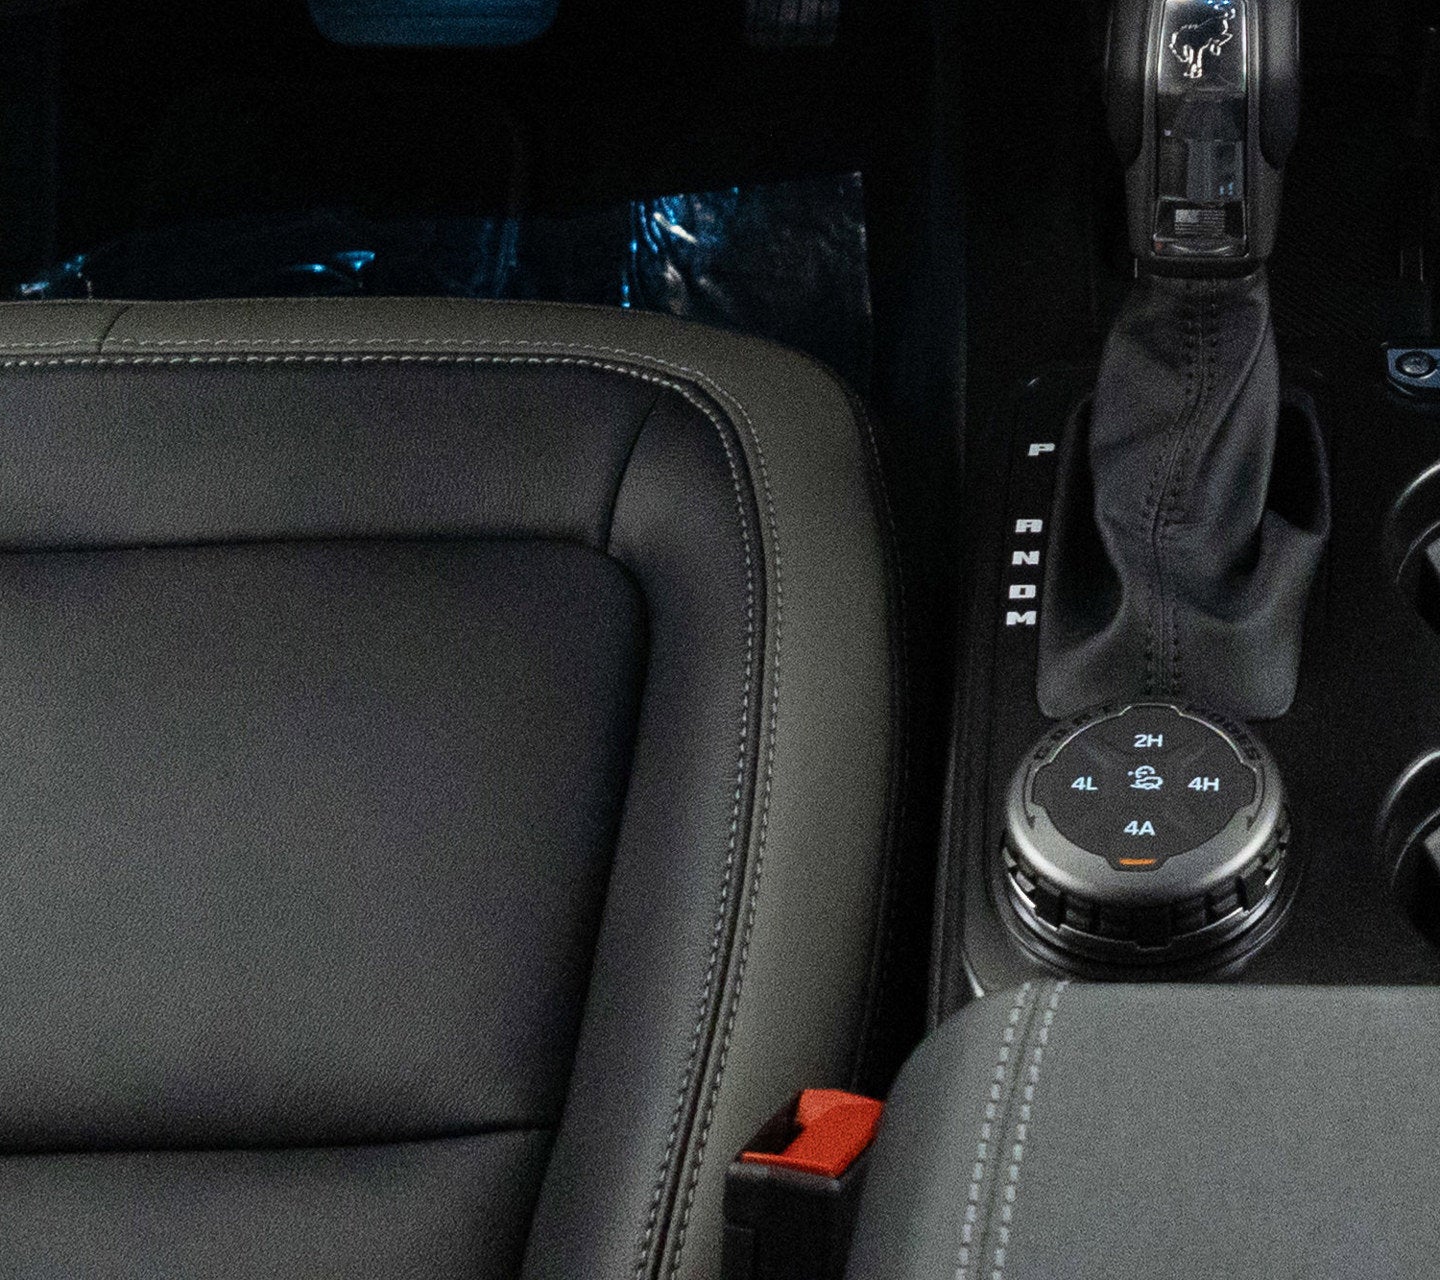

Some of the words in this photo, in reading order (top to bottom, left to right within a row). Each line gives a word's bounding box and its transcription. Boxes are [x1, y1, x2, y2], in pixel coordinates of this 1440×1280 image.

[1028, 443, 1055, 456] P
[1012, 550, 1040, 565] N
[1008, 584, 1036, 599] D
[1005, 610, 1037, 626] M
[1133, 733, 1164, 748] 2H
[1070, 776, 1098, 791] 4L
[1187, 776, 1221, 792] 4H
[1123, 820, 1157, 837] 4A
